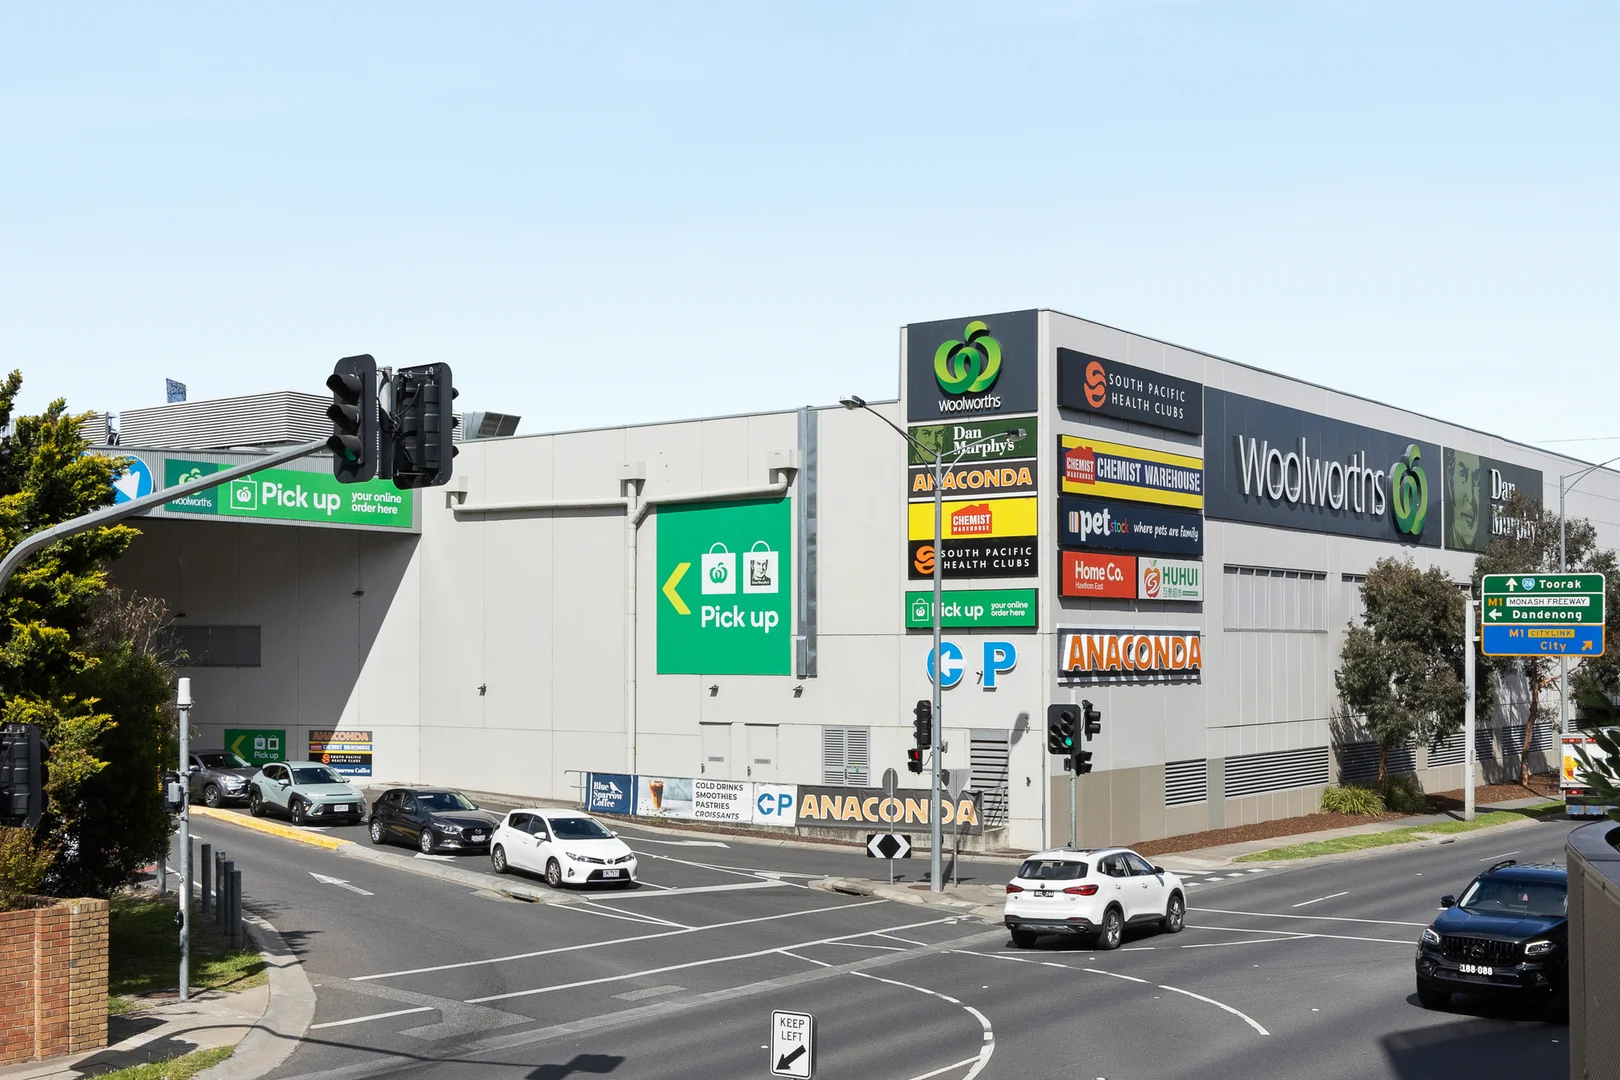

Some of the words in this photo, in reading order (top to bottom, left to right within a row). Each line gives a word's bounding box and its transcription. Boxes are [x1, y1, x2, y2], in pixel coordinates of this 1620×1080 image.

[1109, 373, 1143, 393] SOUTH
[1148, 383, 1186, 403] PACIFIC
[939, 394, 1001, 413] Woolworths
[1111, 392, 1150, 412] HEALTH
[1154, 402, 1184, 420] CLUBS
[953, 425, 982, 441] Dan
[953, 438, 1015, 458] Murphy's
[1066, 457, 1095, 473] CHEMIST
[913, 467, 1033, 492] ANACONDA
[1066, 471, 1094, 481] WAREHOUSE
[1097, 457, 1142, 484] CHEMIST
[1144, 464, 1201, 492] WAREHOUSE
[1238, 434, 1386, 516] Woolworths
[261, 482, 309, 509] Pick
[313, 492, 341, 516] up
[351, 491, 373, 501] your
[373, 491, 402, 503] online
[351, 502, 376, 513] order
[377, 504, 398, 514] here
[952, 514, 991, 526] CHEMIST
[1133, 521, 1154, 534] where
[1154, 525, 1168, 539] pets
[1168, 528, 1180, 537] are
[1180, 525, 1199, 542] family
[940, 549, 980, 558] SOUTH
[985, 547, 1033, 557] PACIFIC
[943, 560, 987, 569] HEALTH
[993, 558, 1030, 568] CLUBS
[1075, 560, 1105, 581] Home
[1107, 562, 1124, 582] Co.
[1162, 566, 1198, 587] HUHUI
[1094, 582, 1104, 591] East
[1539, 579, 1582, 589] Toorak
[1488, 598, 1502, 606] M1
[1509, 598, 1545, 606] MONASH
[1547, 598, 1587, 606] FREEWAY
[964, 608, 984, 620] up
[991, 609, 1009, 617] order
[1512, 609, 1582, 622] Dandenong
[701, 605, 745, 628] Pick
[750, 611, 779, 634] up
[1509, 629, 1525, 638] M1
[1063, 634, 1202, 671] ANACONDA
[1540, 641, 1566, 653] City
[983, 641, 1017, 687] P
[313, 731, 369, 741] ANACONDA
[254, 751, 269, 759] Pick
[593, 781, 609, 791] Blue
[695, 782, 715, 790] COLD
[716, 783, 744, 792] DRINKS
[593, 790, 623, 801] Sparrow
[695, 791, 738, 801] SMOOTHIES
[593, 798, 615, 808] Coffee
[695, 801, 730, 810] PASTRIES
[695, 810, 740, 820] CROISSANTS
[799, 794, 979, 826] ANACONDA
[780, 1017, 805, 1029] KEEP
[781, 1031, 803, 1042] LEFT
